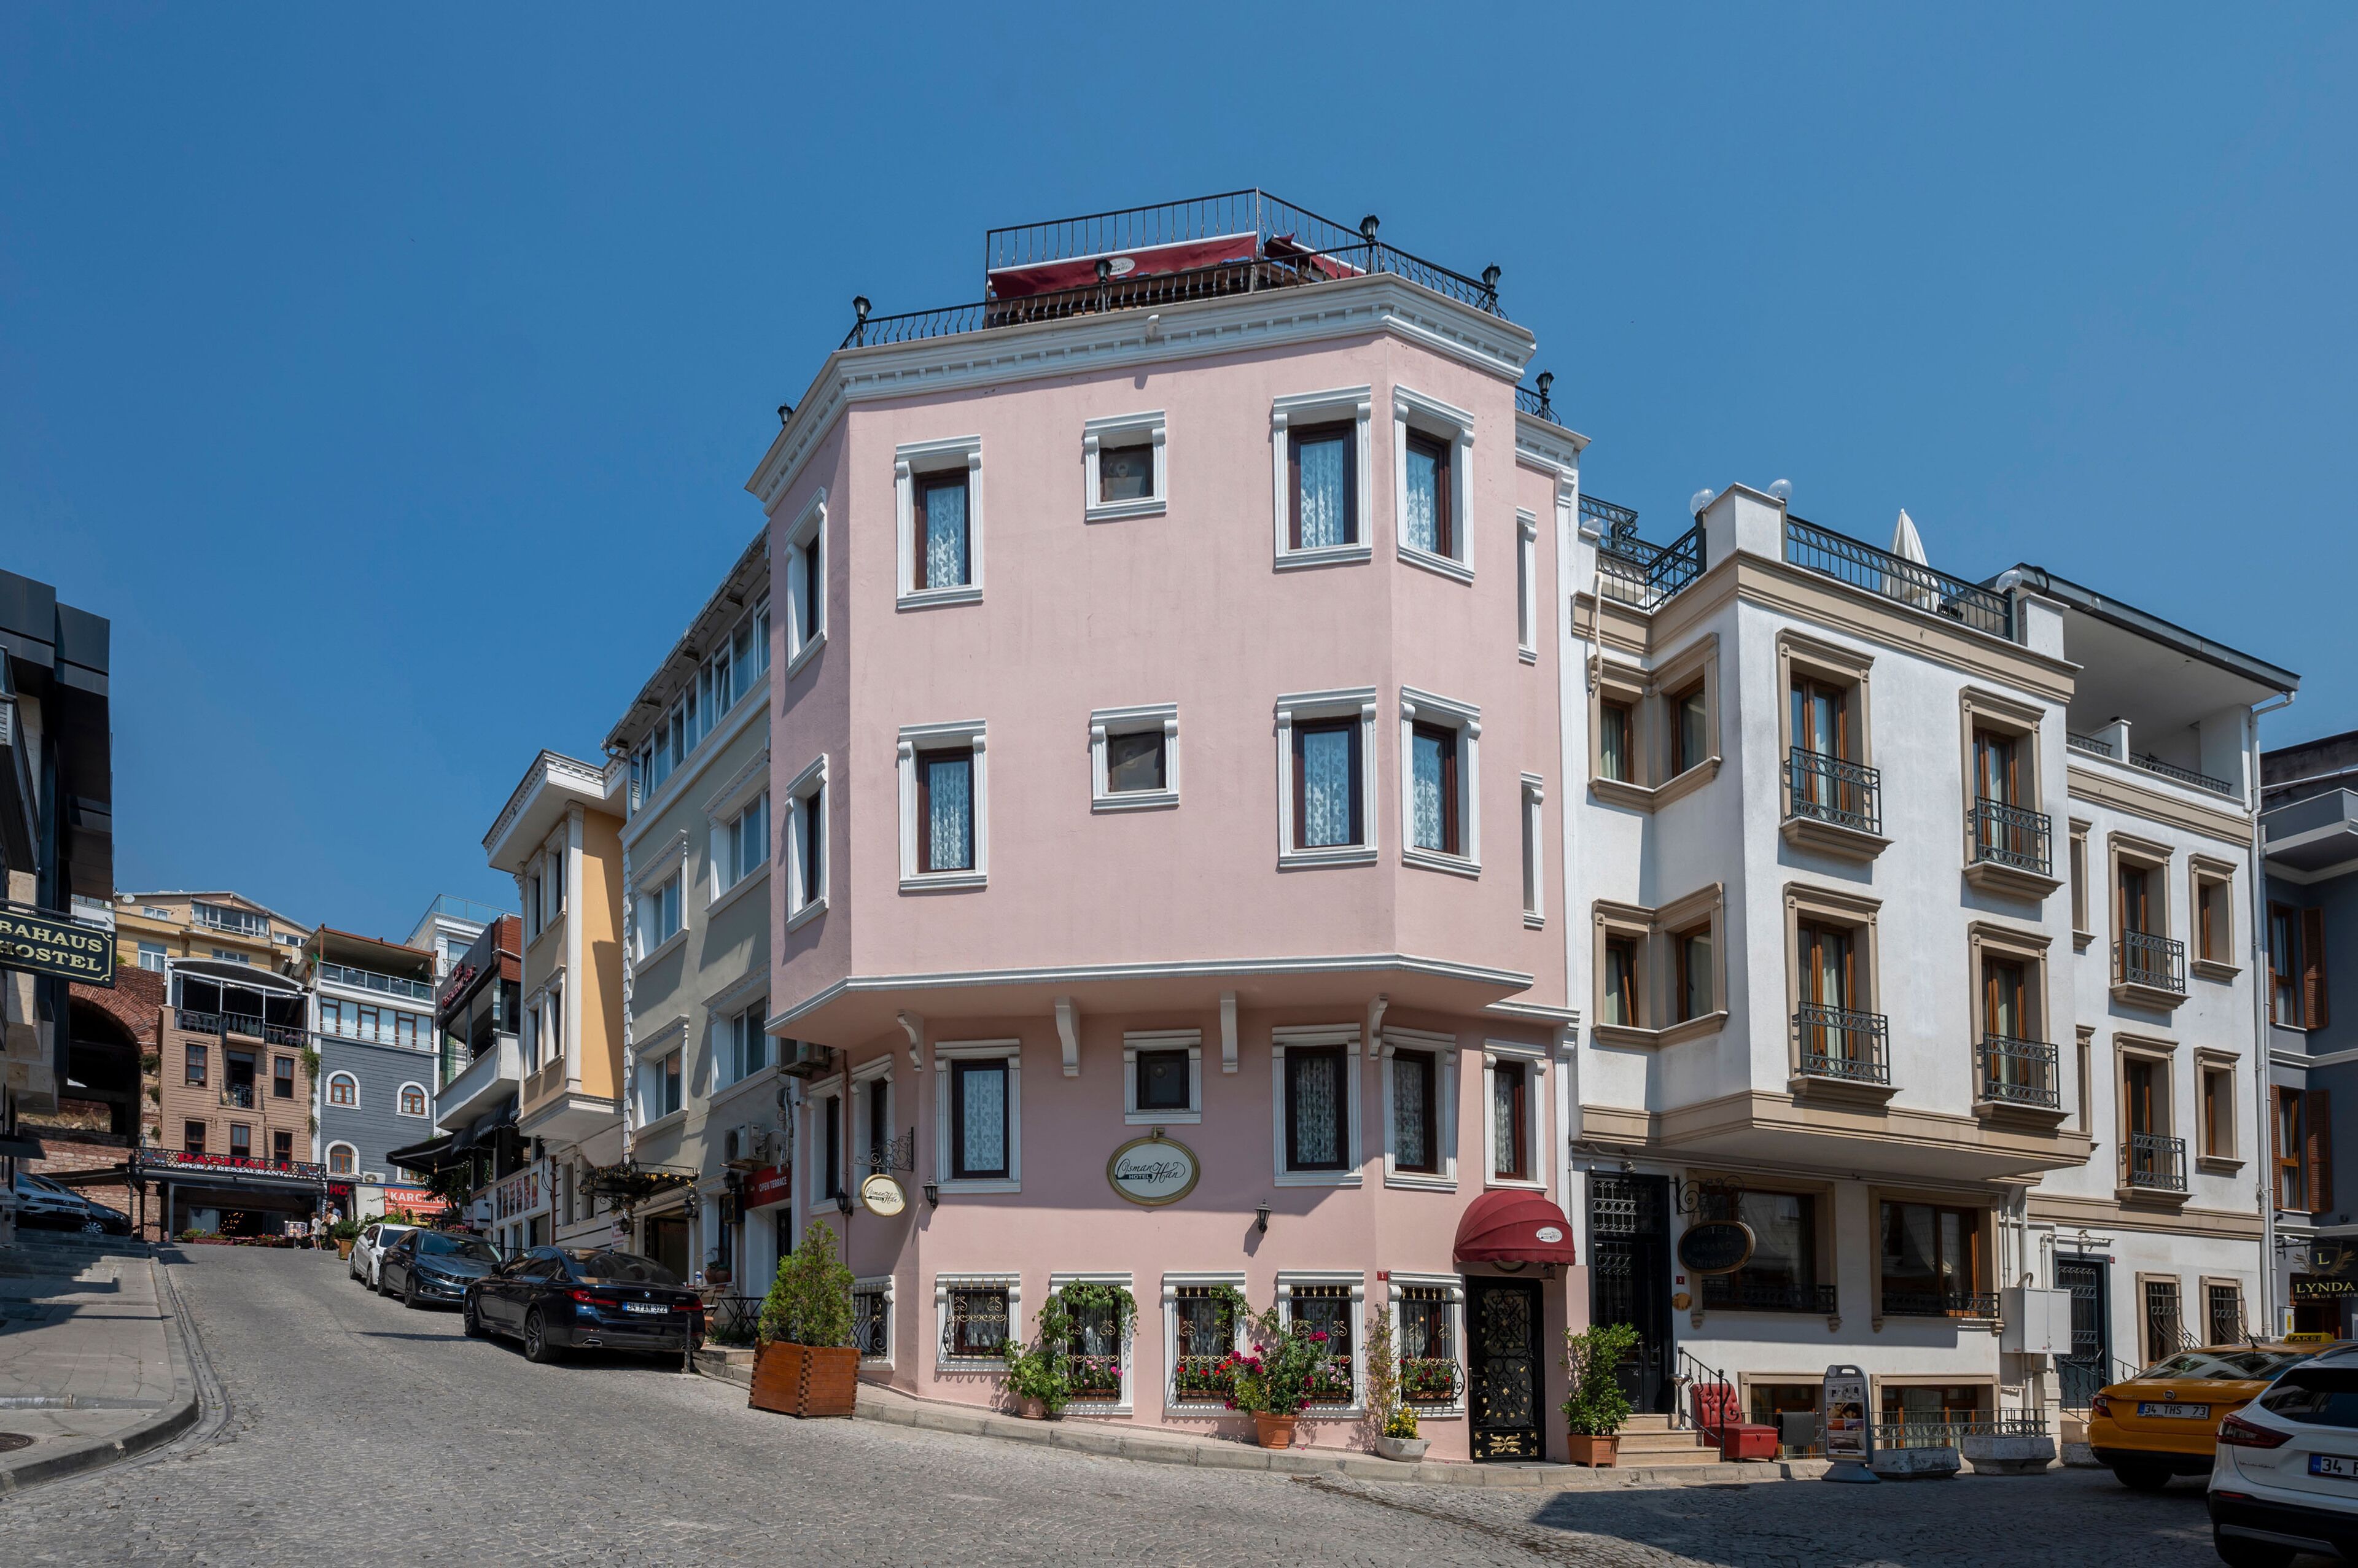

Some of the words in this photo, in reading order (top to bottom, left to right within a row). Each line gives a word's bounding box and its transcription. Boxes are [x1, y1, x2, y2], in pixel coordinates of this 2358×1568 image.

[0, 921, 103, 952] BAHAUS
[0, 940, 102, 972] HOSTEL
[216, 1166, 285, 1177] RESTAURANT
[1117, 1158, 1153, 1179] Osman
[1148, 1162, 1186, 1184] Han
[758, 1181, 770, 1192] OPEN
[769, 1176, 787, 1189] TERRACE
[1697, 1226, 1731, 1236] HOTEL
[1694, 1242, 1732, 1252] GRAND
[2317, 1252, 2330, 1265] L
[2295, 1281, 2356, 1294] LYNDA
[2145, 1405, 2157, 1414] 34
[2164, 1405, 2183, 1415] THS
[2193, 1406, 2206, 1416] 73
[2322, 1458, 2342, 1473] 34
